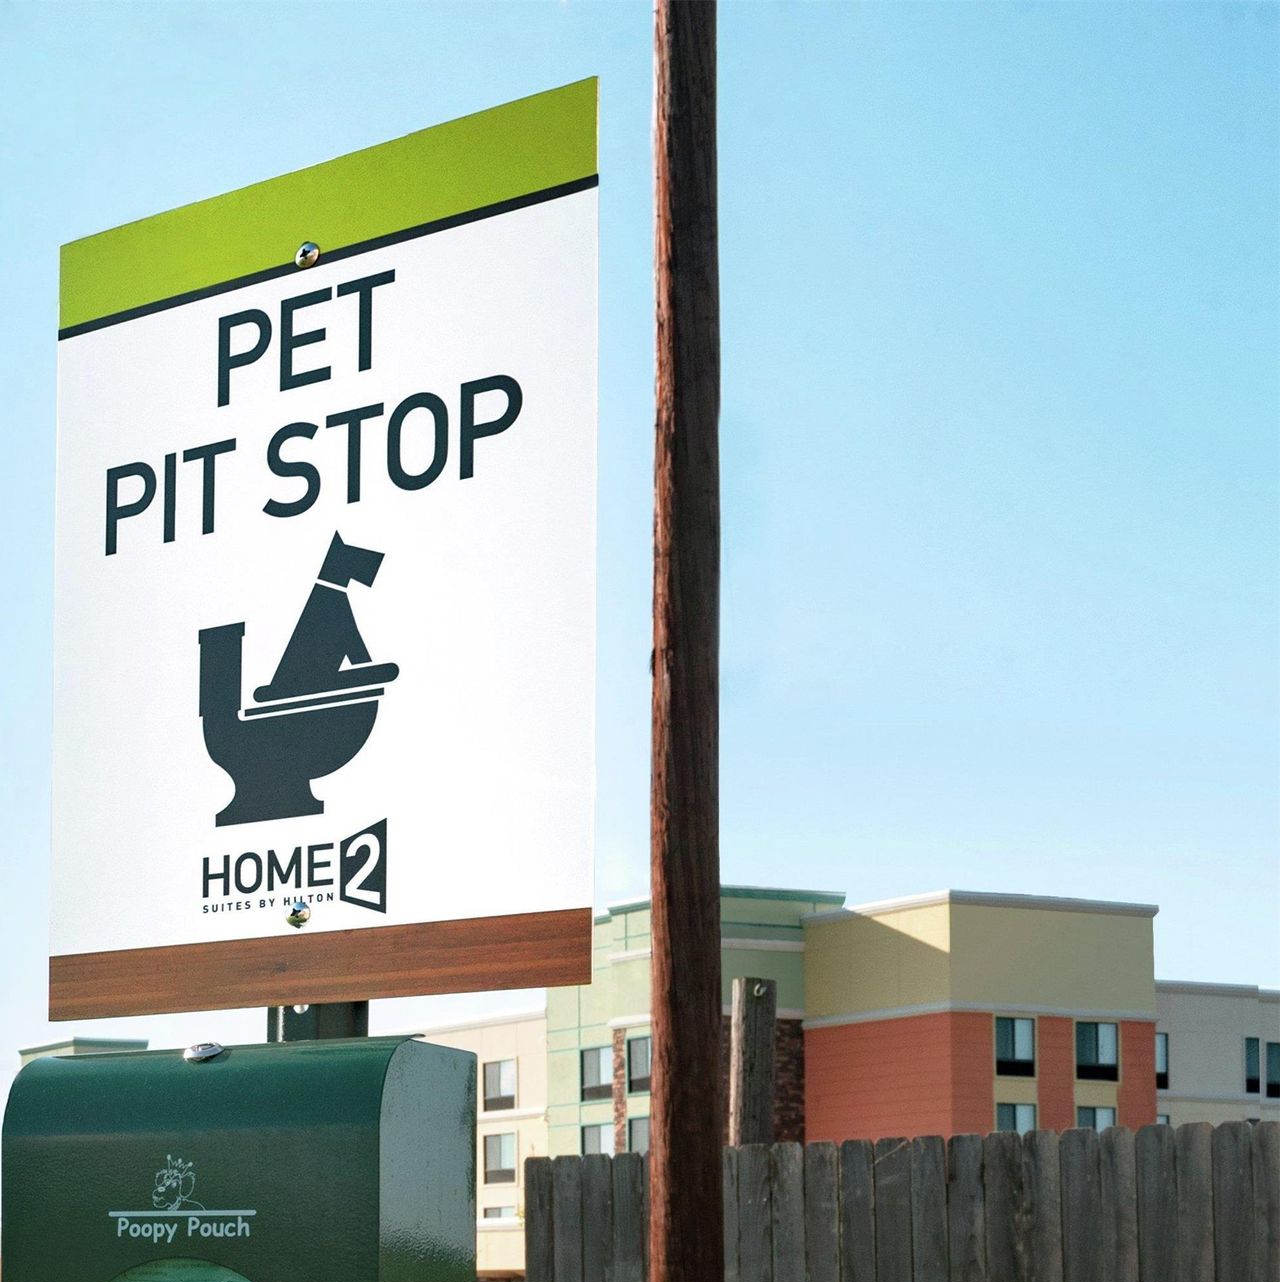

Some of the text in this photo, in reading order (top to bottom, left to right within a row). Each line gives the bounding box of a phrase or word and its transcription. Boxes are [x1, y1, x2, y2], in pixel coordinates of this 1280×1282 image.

[217, 268, 396, 408] PET
[104, 374, 524, 556] PIT STOP
[202, 901, 251, 914] SUITES
[259, 898, 275, 908] BY
[117, 1216, 251, 1243] Poopy Pouch
